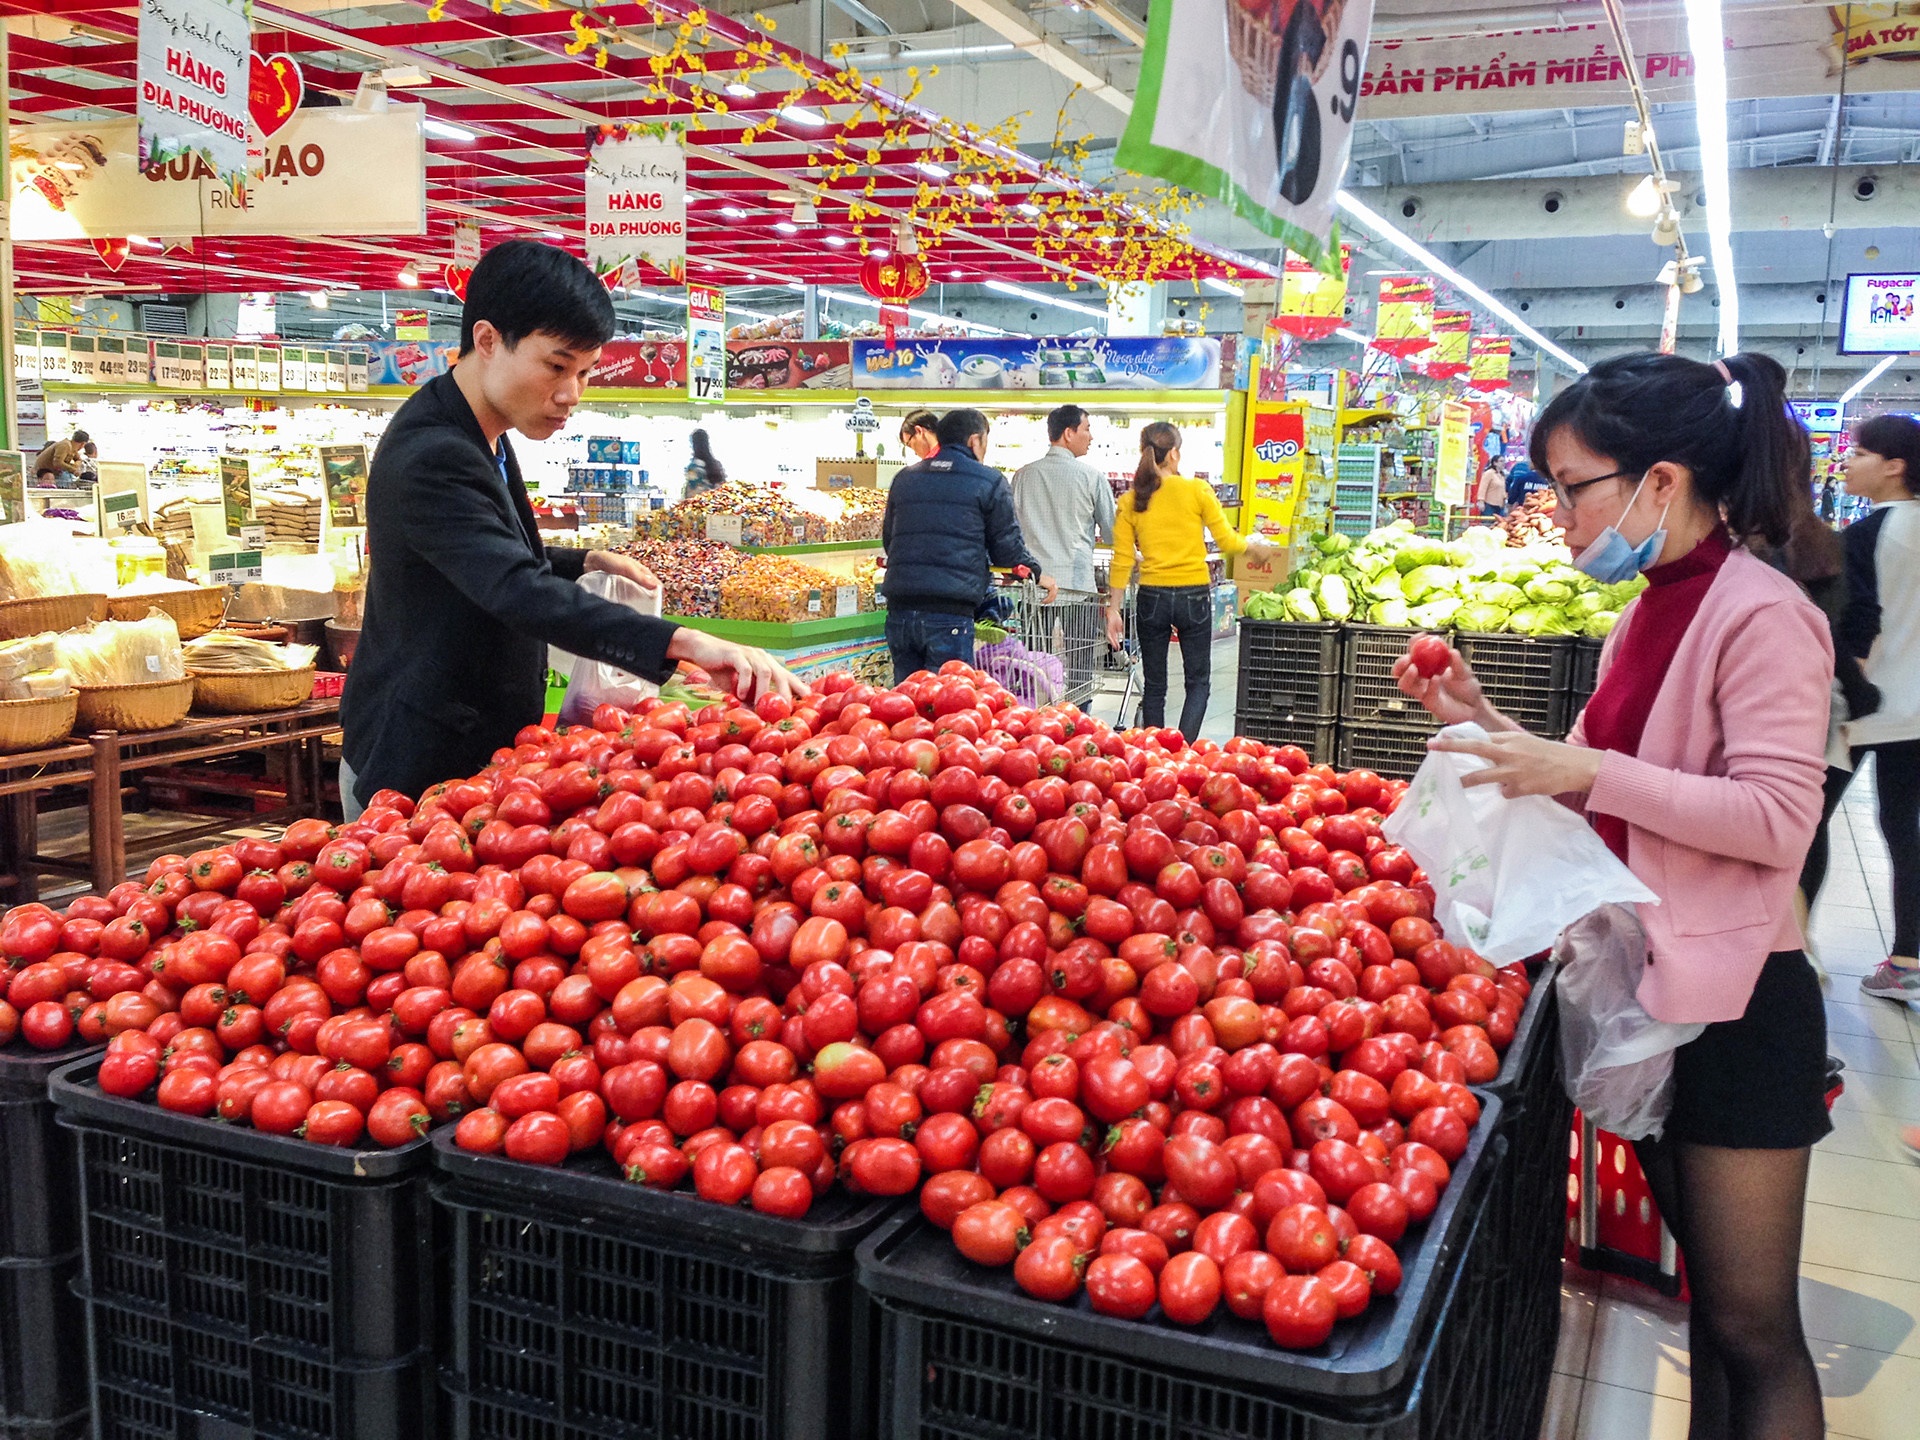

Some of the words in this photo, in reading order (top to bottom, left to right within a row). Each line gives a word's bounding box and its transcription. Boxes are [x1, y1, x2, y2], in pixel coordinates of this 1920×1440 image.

[1878, 22, 1919, 44] TỐT
[166, 46, 227, 97] HÀNG
[1359, 62, 1425, 97] SẢN
[1433, 51, 1537, 92] PHẨM
[1545, 43, 1628, 85] MIỄN
[1645, 52, 1696, 79] PH
[142, 80, 175, 112] ĐỊA
[178, 94, 246, 141] PHƯƠNG
[607, 189, 663, 211] HÀNG
[589, 221, 616, 239] ĐỊA
[619, 219, 682, 236] PHƯƠNG
[1867, 278, 1916, 290] Fugacar
[690, 290, 710, 310] GIÁ
[710, 293, 724, 313] RẺ
[43, 356, 56, 370] 33
[71, 360, 84, 375] 32
[99, 360, 113, 375] 44
[127, 359, 139, 373] 23
[865, 351, 895, 373] Wel
[895, 348, 915, 367] Yo
[161, 366, 170, 380] 17
[180, 367, 191, 382] 20
[208, 366, 219, 380] 22
[235, 366, 246, 380] 34
[259, 370, 269, 383] 36
[694, 376, 712, 397] 17
[116, 511, 126, 522] 16
[214, 571, 226, 582] 165
